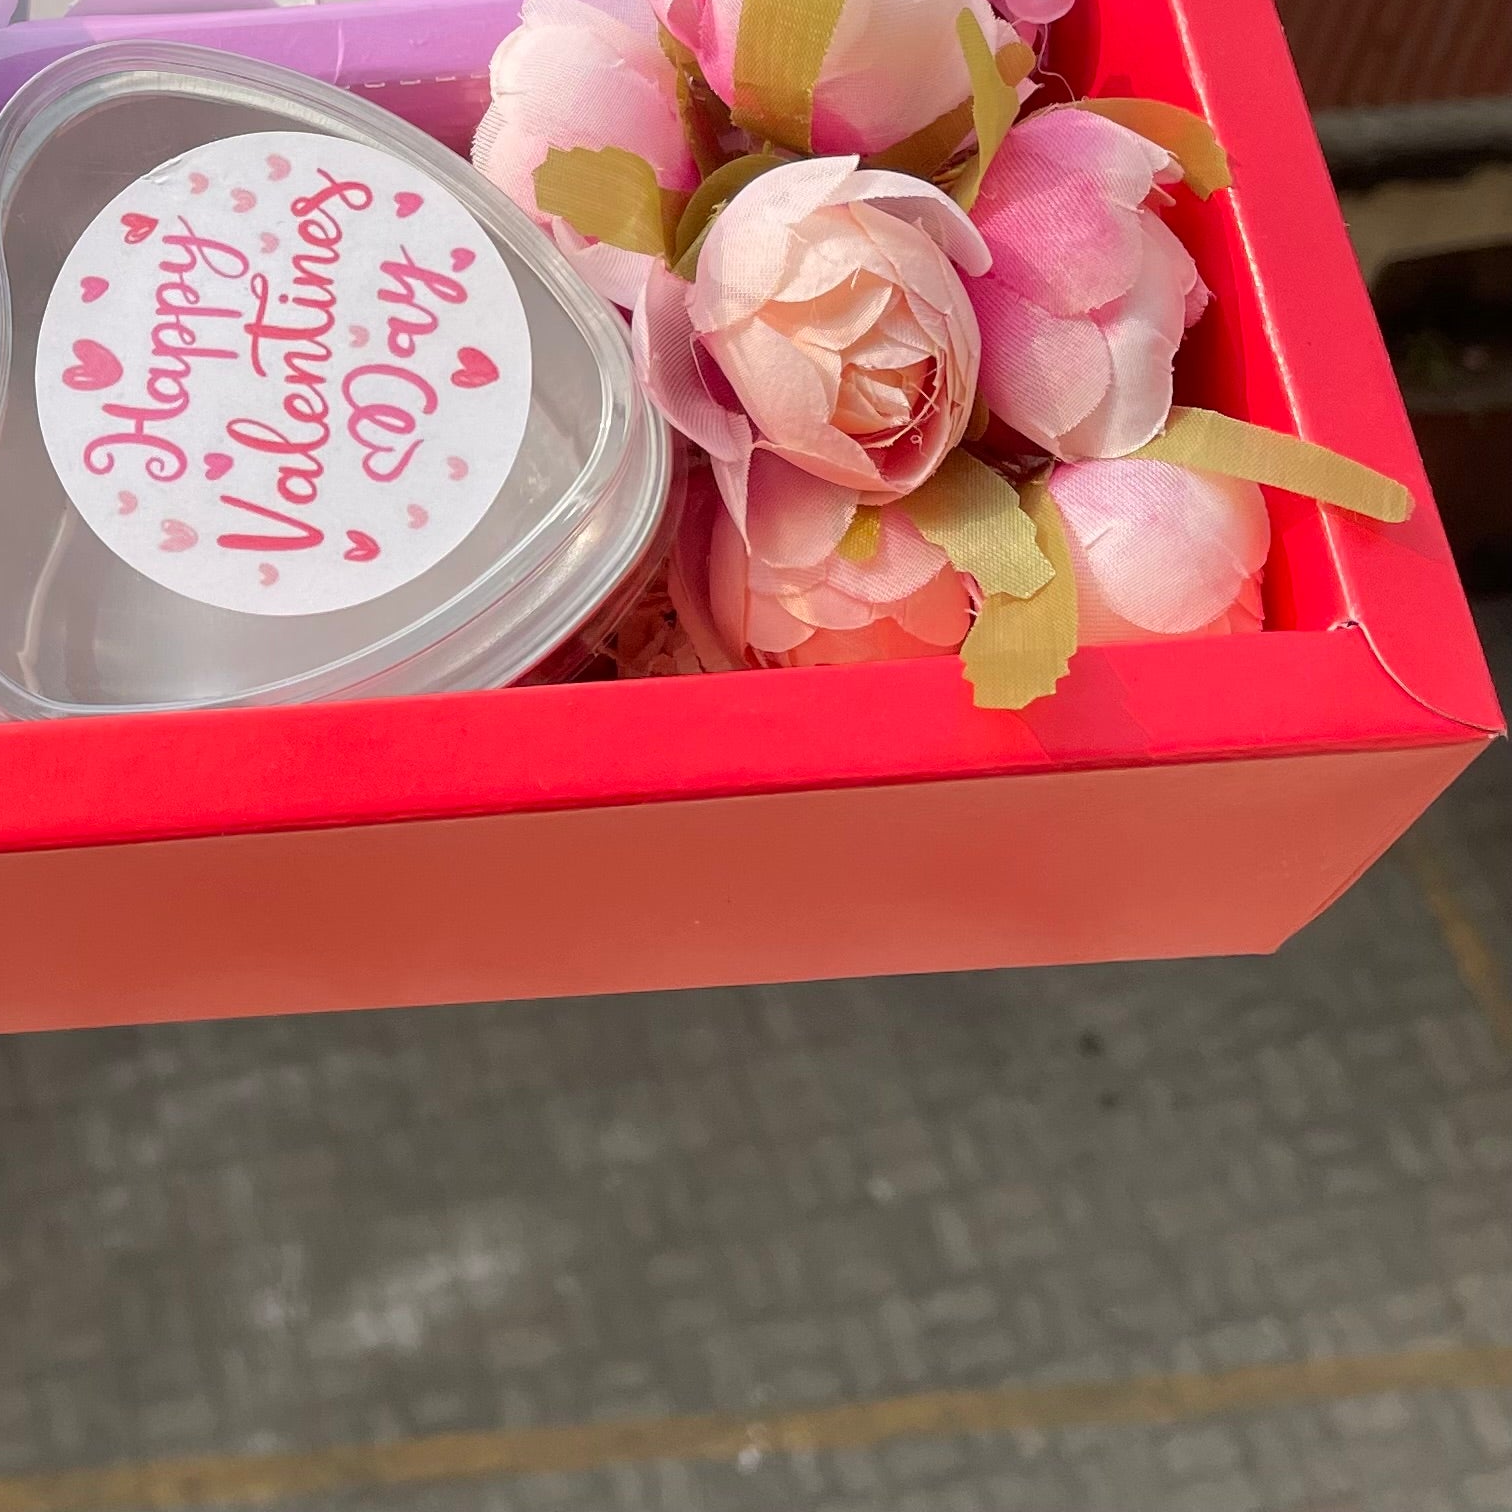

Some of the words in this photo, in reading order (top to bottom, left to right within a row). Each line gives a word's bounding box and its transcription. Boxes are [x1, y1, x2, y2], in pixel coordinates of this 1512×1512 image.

[83, 215, 250, 483] Happy
[216, 168, 373, 552] Valentines
[341, 245, 469, 483] Day
